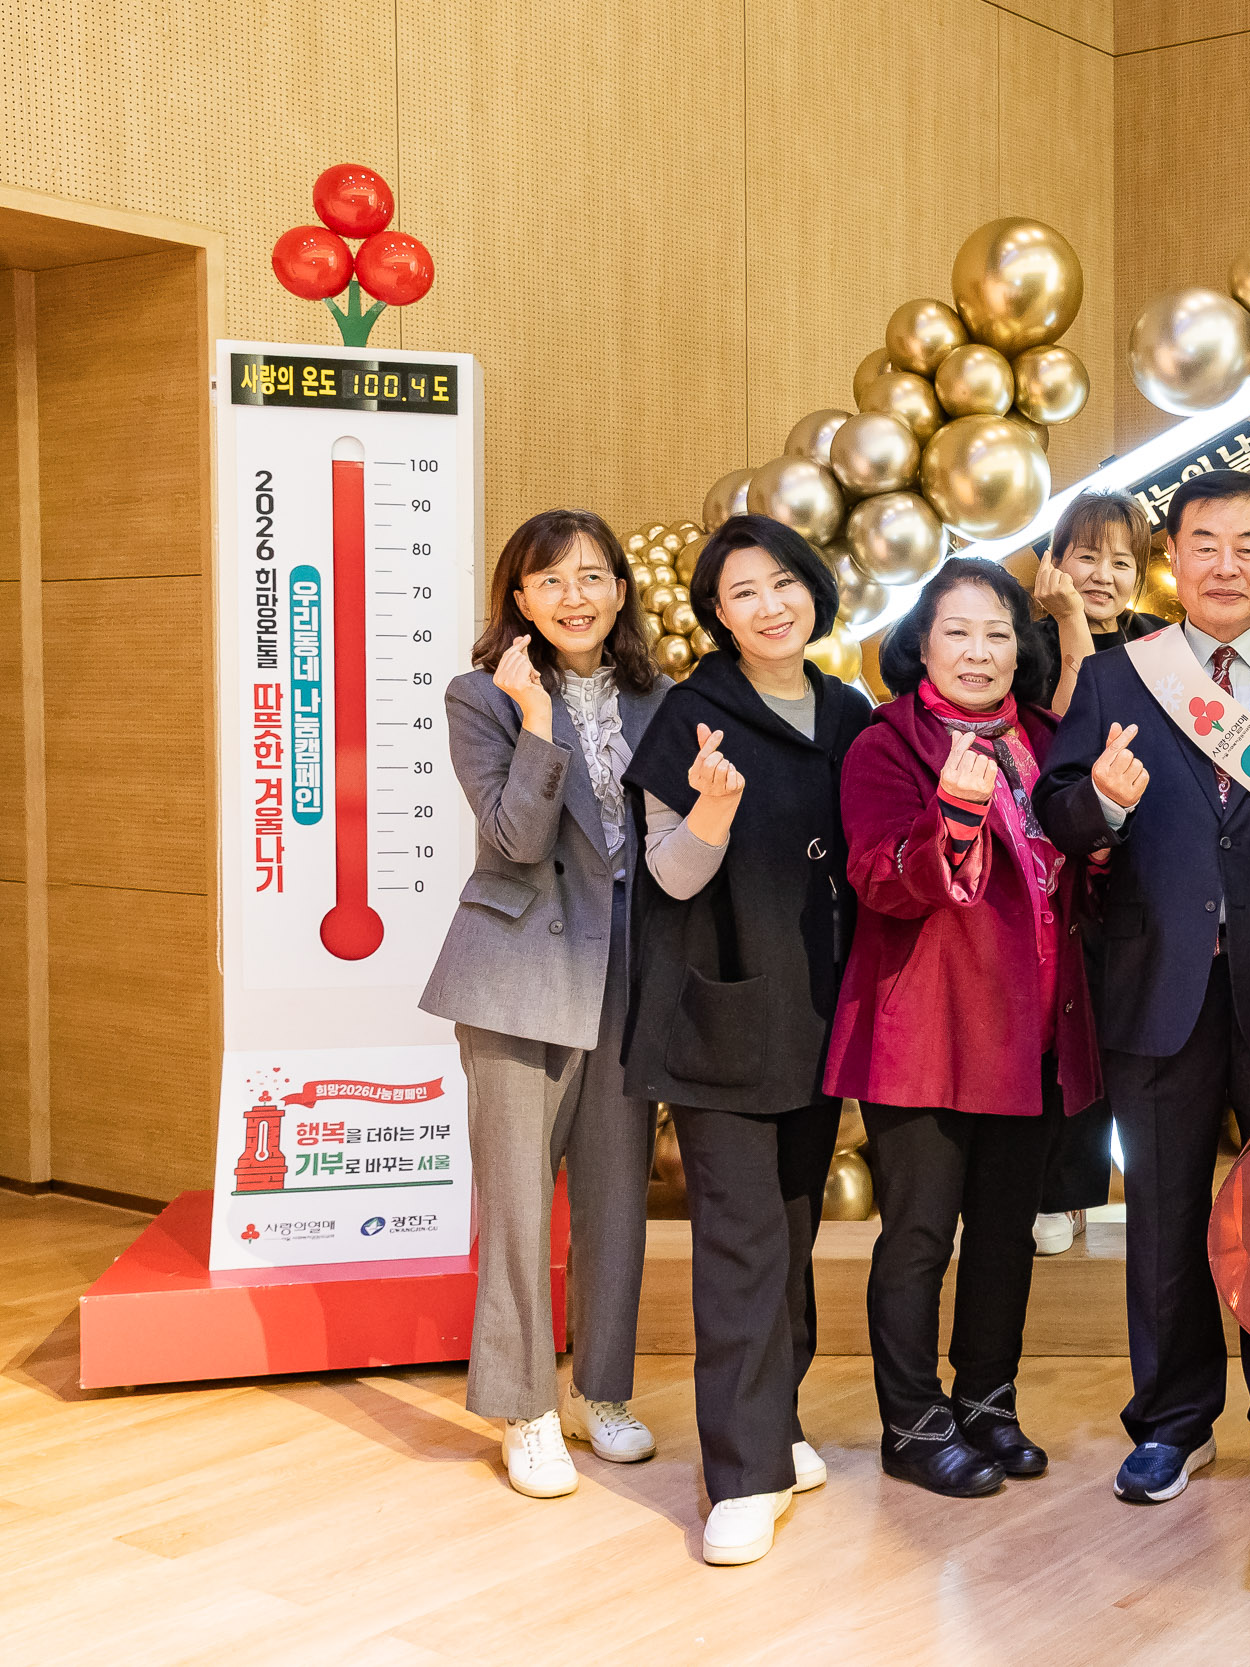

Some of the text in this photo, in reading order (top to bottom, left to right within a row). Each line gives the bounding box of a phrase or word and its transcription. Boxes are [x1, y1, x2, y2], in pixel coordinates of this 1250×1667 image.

[241, 364, 449, 402] 사랑의 온도 100.4 도
[410, 459, 438, 472] 100
[411, 499, 431, 512] 90
[412, 543, 431, 556] 80
[412, 586, 432, 599] 70
[412, 630, 432, 643] 60
[253, 470, 285, 893] 2026 희망온돌 따뜻한 겨울나기
[412, 673, 432, 686] 50
[293, 581, 321, 813] 우리동네 나눔캠페인
[413, 717, 433, 730] 40
[413, 761, 433, 774] 30
[414, 805, 433, 818] 20
[415, 846, 434, 858] 10
[414, 880, 424, 893] 0
[297, 1121, 450, 1146] 행복을 더하는 기부
[295, 1152, 450, 1176] 기부로 바꾸는 서울
[391, 1215, 437, 1227] 광진구
